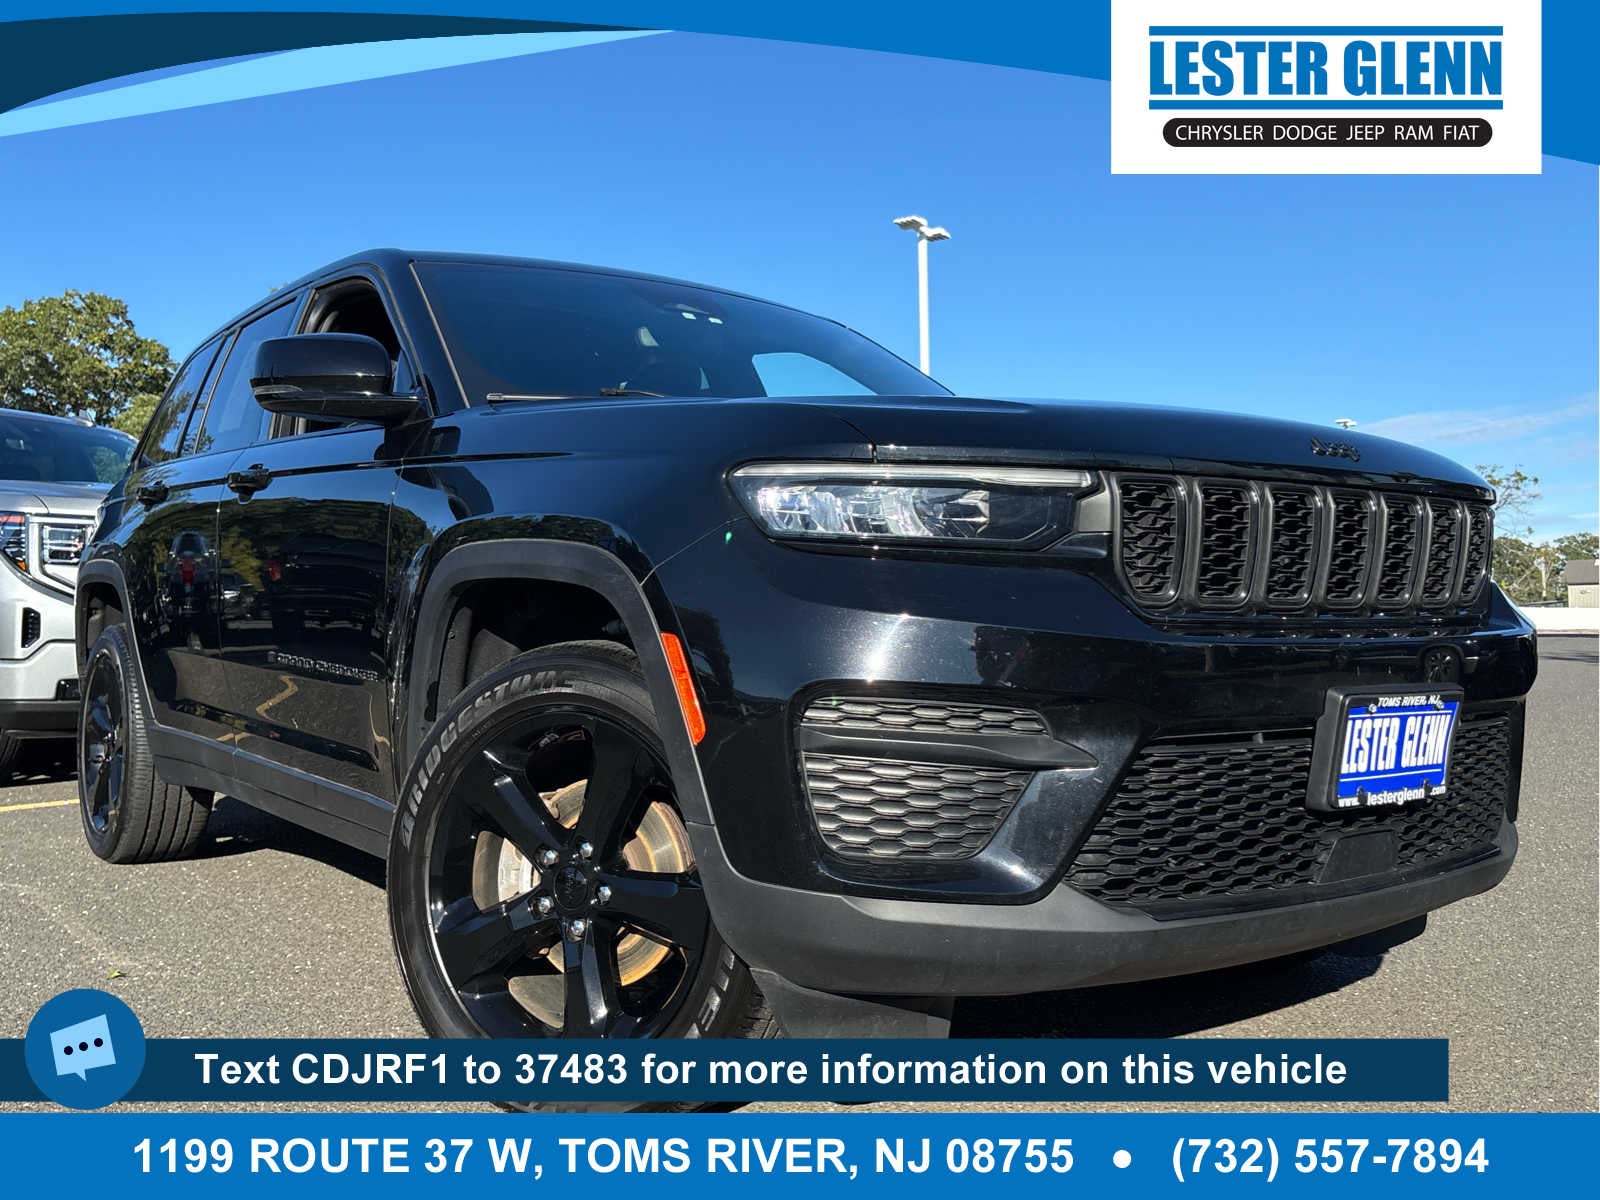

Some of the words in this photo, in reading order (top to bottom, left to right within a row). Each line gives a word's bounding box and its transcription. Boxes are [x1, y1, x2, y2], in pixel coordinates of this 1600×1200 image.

[1377, 696, 1401, 708] TOMS
[1340, 717, 1401, 774] LESTER
[1400, 714, 1451, 768] GLENN
